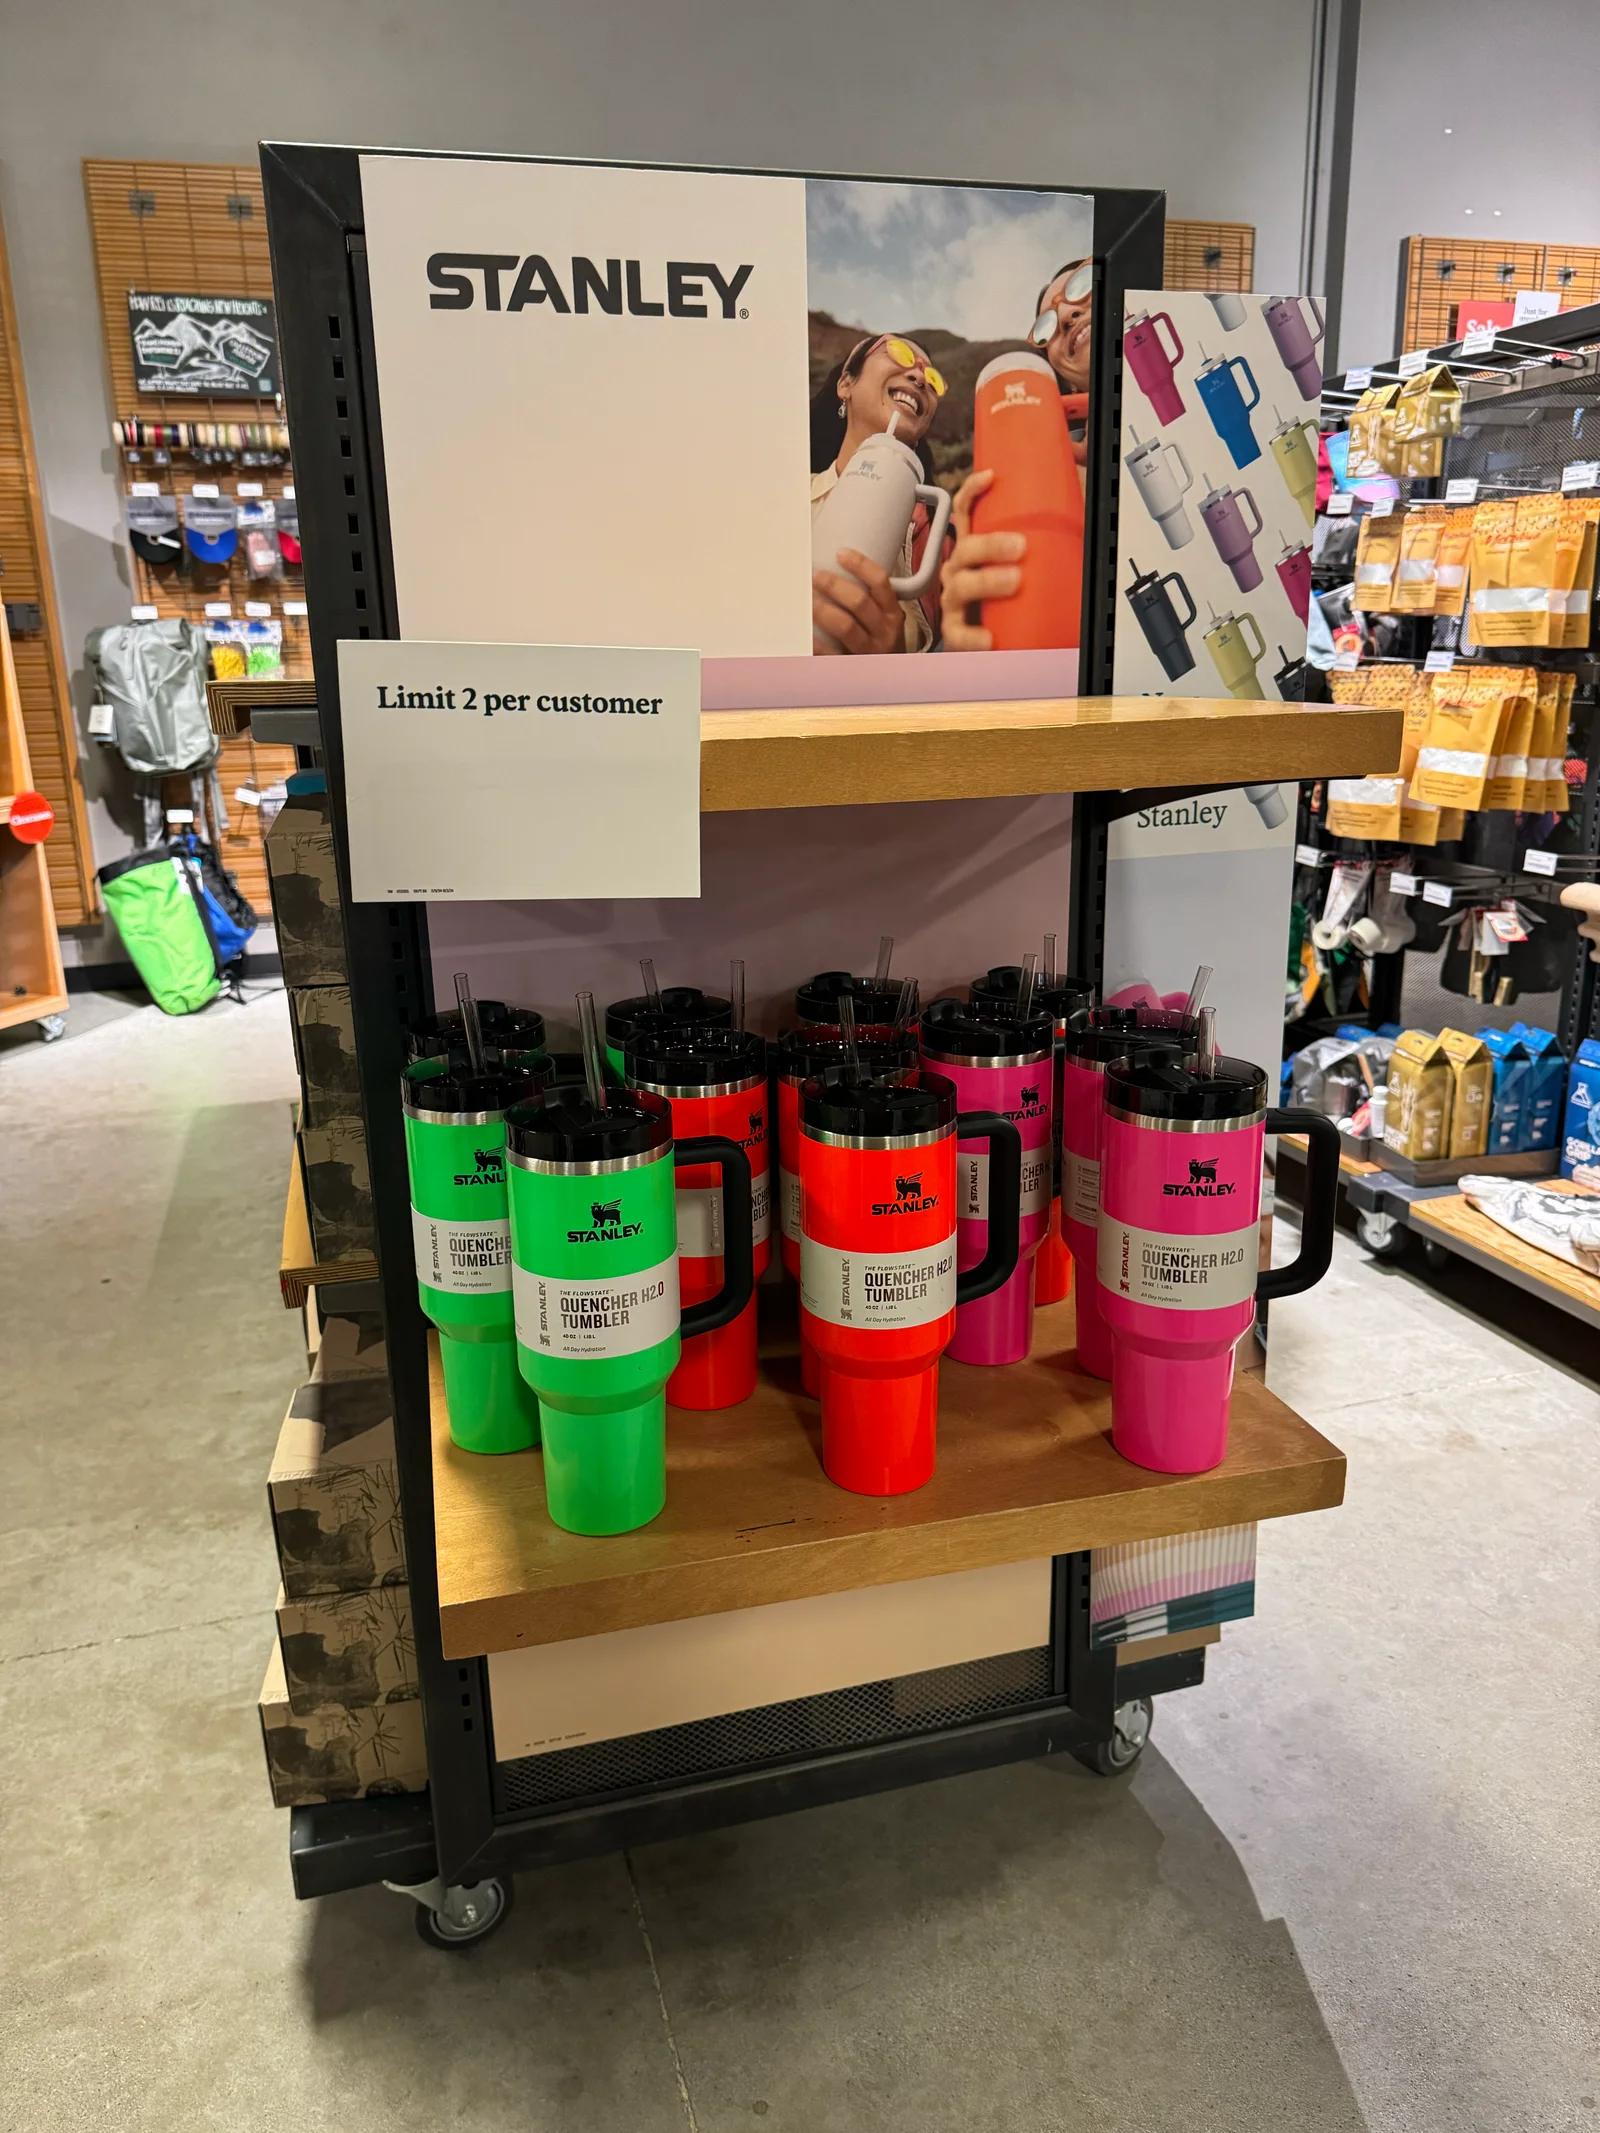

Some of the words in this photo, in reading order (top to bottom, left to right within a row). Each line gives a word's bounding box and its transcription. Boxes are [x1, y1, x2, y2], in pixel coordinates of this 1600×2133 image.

[377, 685, 456, 709] Limit
[462, 688, 477, 710] 2
[484, 692, 530, 716] per
[536, 691, 663, 715] customer
[1137, 800, 1228, 829] Stanley
[431, 1224, 439, 1269] STANLEY
[450, 1250, 512, 1267] TUMBLER
[1122, 1231, 1130, 1278] STANLEY
[1142, 1249, 1217, 1268] QUENCHER
[1221, 1248, 1244, 1266] H2.0
[842, 1258, 850, 1306] STANLEY
[865, 1265, 934, 1287] QUENCHER
[1142, 1264, 1208, 1283] TUMBLER
[538, 1281, 548, 1331] STANLEY
[560, 1291, 638, 1313] QUENCHER
[641, 1281, 664, 1303] H2.0
[864, 1283, 927, 1303] TUMBLER
[560, 1310, 630, 1329] TUMBLER
